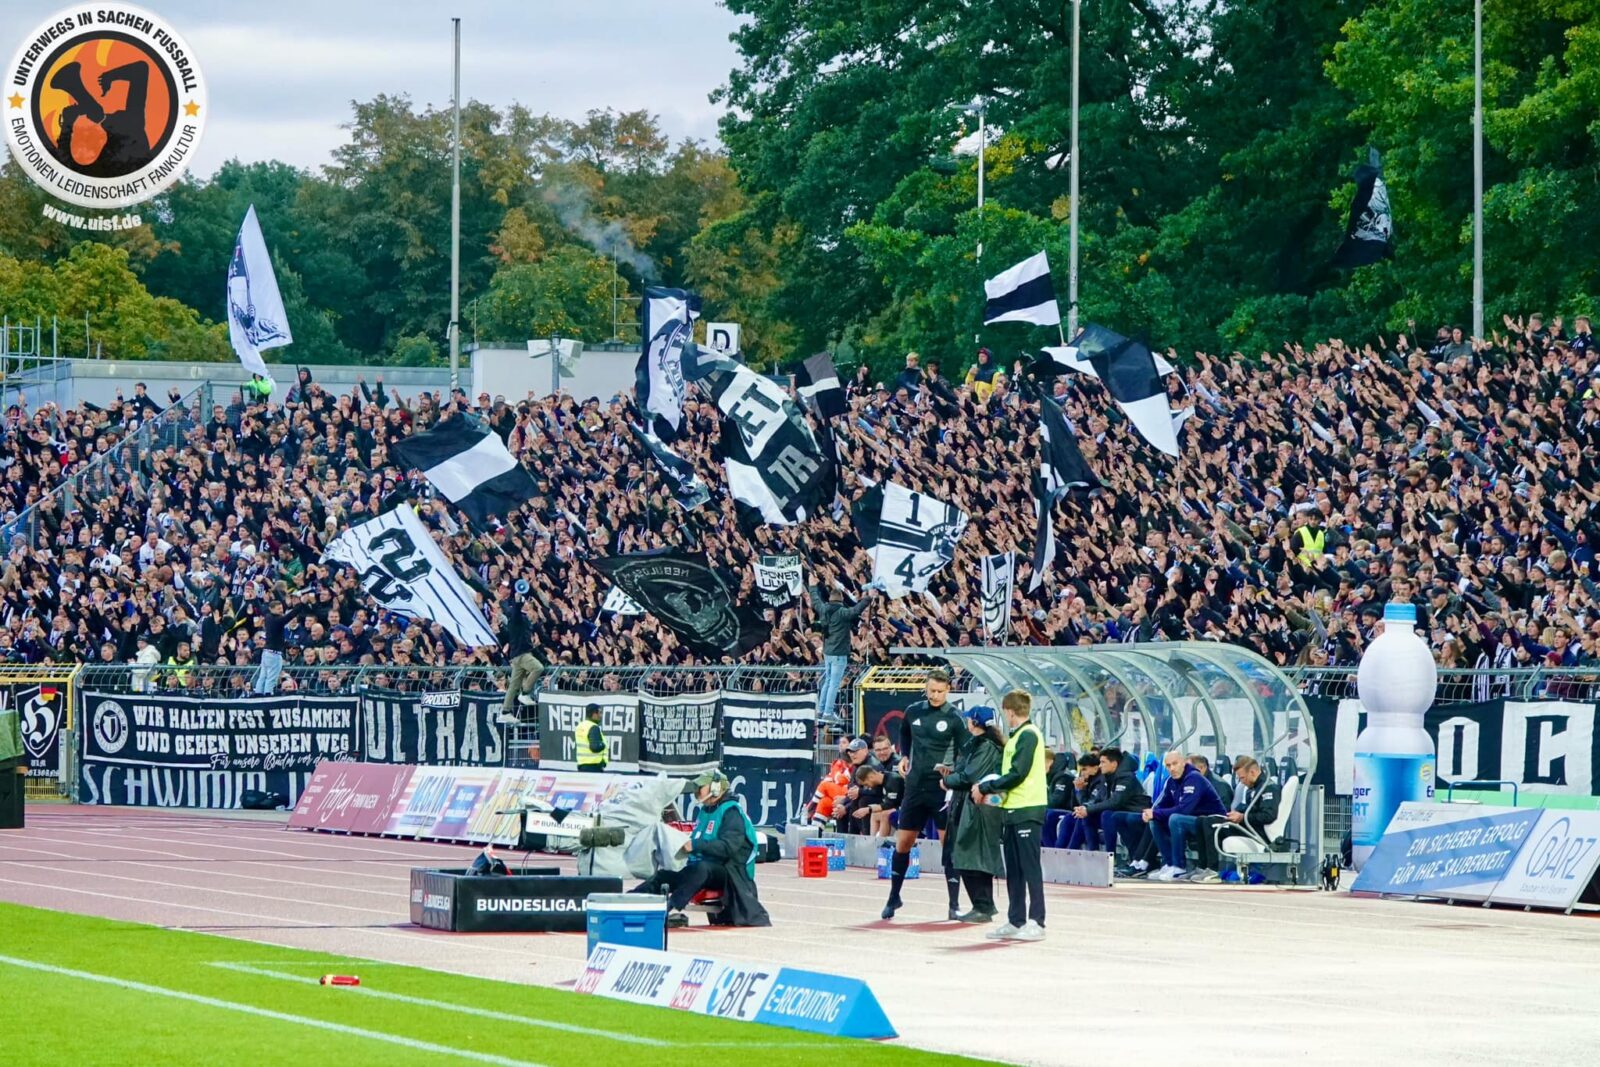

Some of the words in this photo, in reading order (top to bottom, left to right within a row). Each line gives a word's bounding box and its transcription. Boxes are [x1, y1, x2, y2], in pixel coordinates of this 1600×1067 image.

[905, 492, 922, 528] 1
[894, 553, 915, 588] 4
[133, 705, 164, 727] WIR
[169, 708, 225, 730] HALTEN
[228, 709, 265, 729] FEST
[269, 707, 350, 729] ZUSAMMEN
[731, 719, 807, 739] constante
[760, 708, 782, 719] nero
[136, 731, 170, 753] UND
[174, 734, 230, 755] GEHEN
[234, 733, 311, 754] UNSEREN
[315, 733, 349, 753] WEG
[1406, 836, 1430, 858] EIN
[1427, 827, 1483, 853] SICHERER
[1480, 820, 1528, 845] ERFOLG
[1389, 858, 1416, 886] FÜR
[1413, 859, 1443, 882] IHRE
[610, 960, 672, 998] ADDITIVE
[764, 983, 847, 1024] E-RECRUITING
